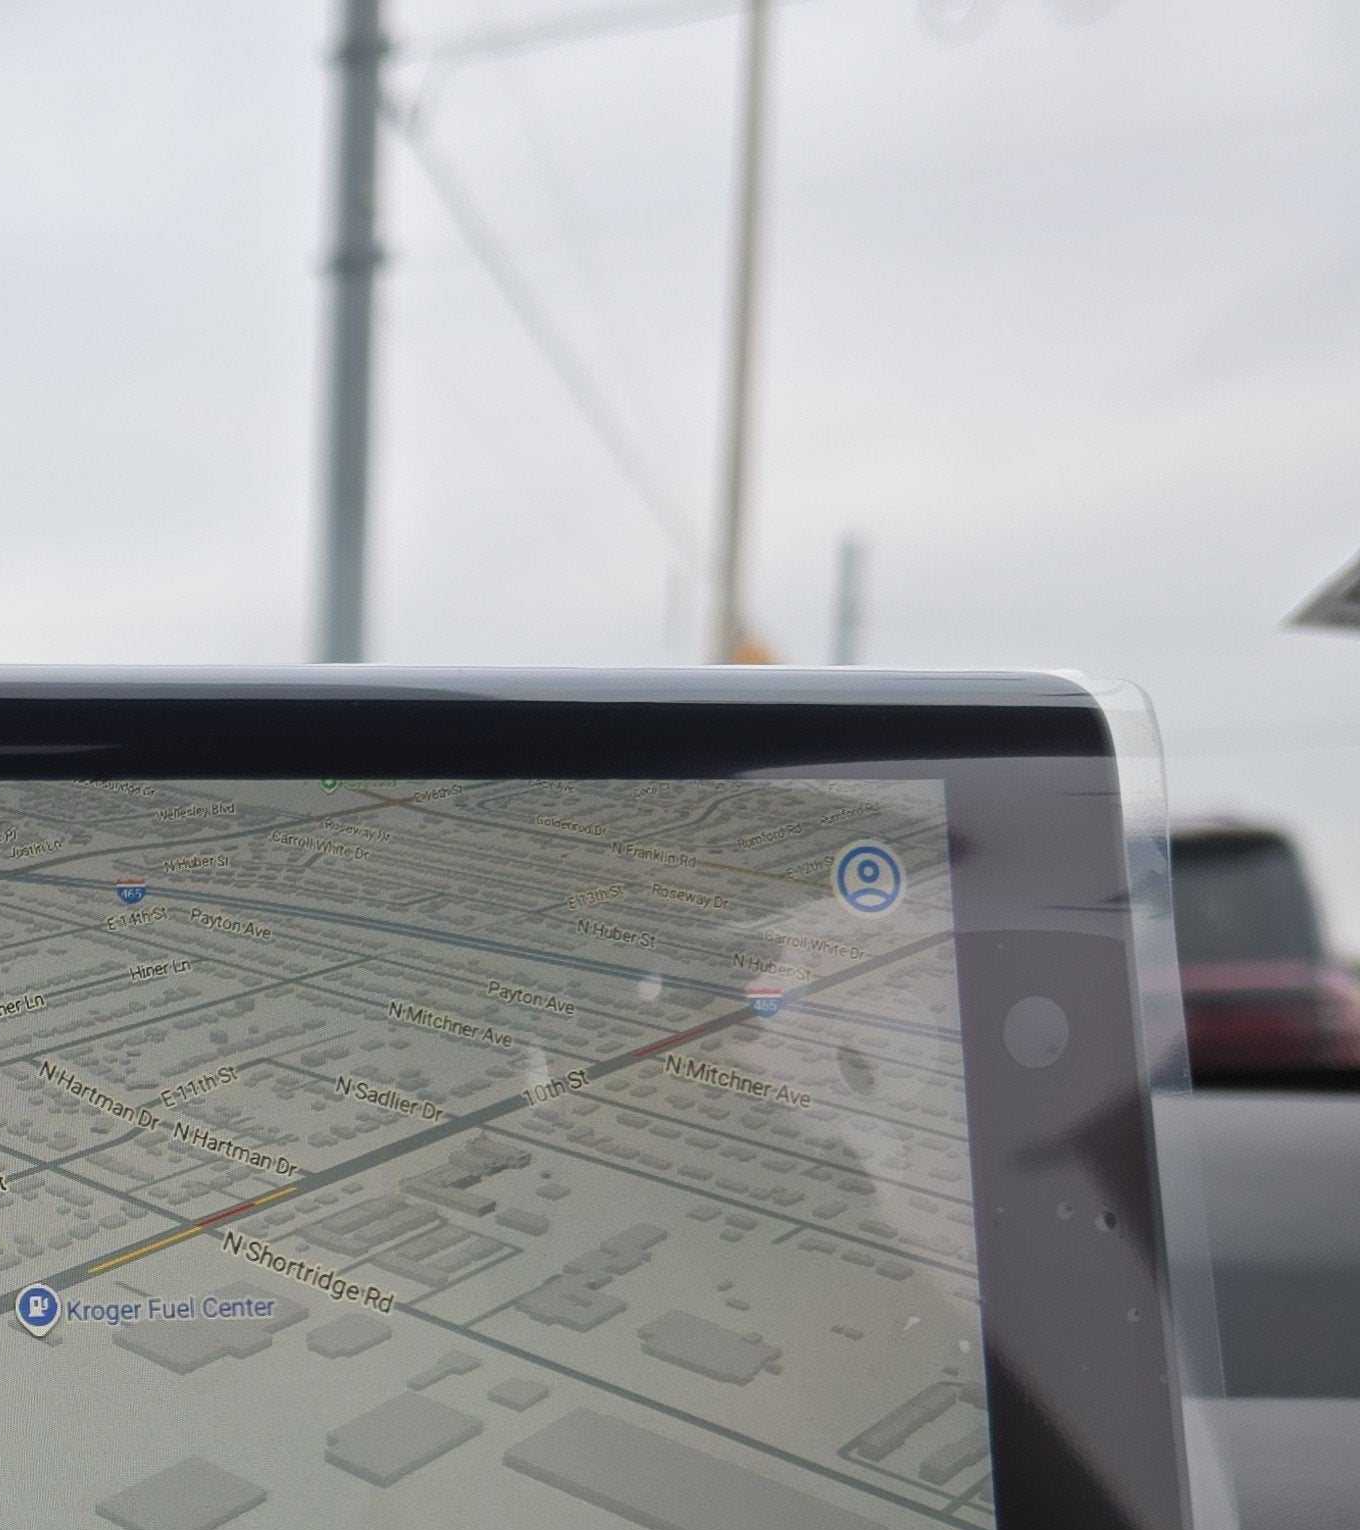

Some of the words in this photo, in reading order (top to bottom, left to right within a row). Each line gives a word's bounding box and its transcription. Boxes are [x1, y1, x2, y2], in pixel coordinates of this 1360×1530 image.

[612, 841, 622, 854] N
[626, 845, 677, 864] Franklin
[679, 856, 697, 868] Rd
[567, 897, 577, 910] E
[579, 889, 608, 906] 13th
[609, 885, 623, 898] St
[651, 884, 713, 909] Roseway
[714, 896, 729, 909] Dr
[107, 918, 118, 930] E
[153, 906, 168, 920] St
[190, 908, 241, 933] Payton
[243, 921, 272, 939] Ave
[578, 919, 588, 933] N
[593, 922, 637, 944] Huber
[639, 933, 656, 948] St
[765, 930, 808, 948] Carroll
[809, 939, 847, 957] White
[849, 947, 866, 960] Dr
[130, 960, 170, 980] Hiner
[171, 956, 191, 974] Ln
[733, 953, 746, 968] N
[748, 956, 793, 977] Huber
[796, 967, 812, 982] St
[24, 992, 45, 1011] Ln
[488, 980, 544, 1011] Payton
[545, 995, 576, 1016] Ave
[754, 1001, 777, 1012] 465
[389, 1001, 404, 1019] N
[407, 1007, 479, 1042] Mitchner
[481, 1027, 514, 1048] Ave
[40, 1060, 56, 1081] N
[57, 1070, 138, 1124] Hartman
[138, 1108, 161, 1131] Dr
[161, 1090, 174, 1109] E
[177, 1074, 212, 1103] 11th
[215, 1065, 238, 1086] St
[523, 1077, 566, 1107] 10th
[567, 1068, 591, 1090] St
[665, 1055, 682, 1074] N
[685, 1058, 773, 1099] Mitchner
[774, 1082, 812, 1109] Ave
[335, 1076, 352, 1096] N
[355, 1082, 419, 1118] Sadlier
[421, 1100, 444, 1122] Dr
[173, 1122, 190, 1142] N
[191, 1131, 274, 1172] Hartman
[275, 1156, 297, 1178] Dr
[223, 1232, 243, 1255] N
[244, 1238, 362, 1304] Shortridge
[363, 1288, 395, 1314] Rd
[67, 1297, 141, 1325] Kroger
[149, 1296, 195, 1319] Fuel
[204, 1294, 275, 1319] Center
